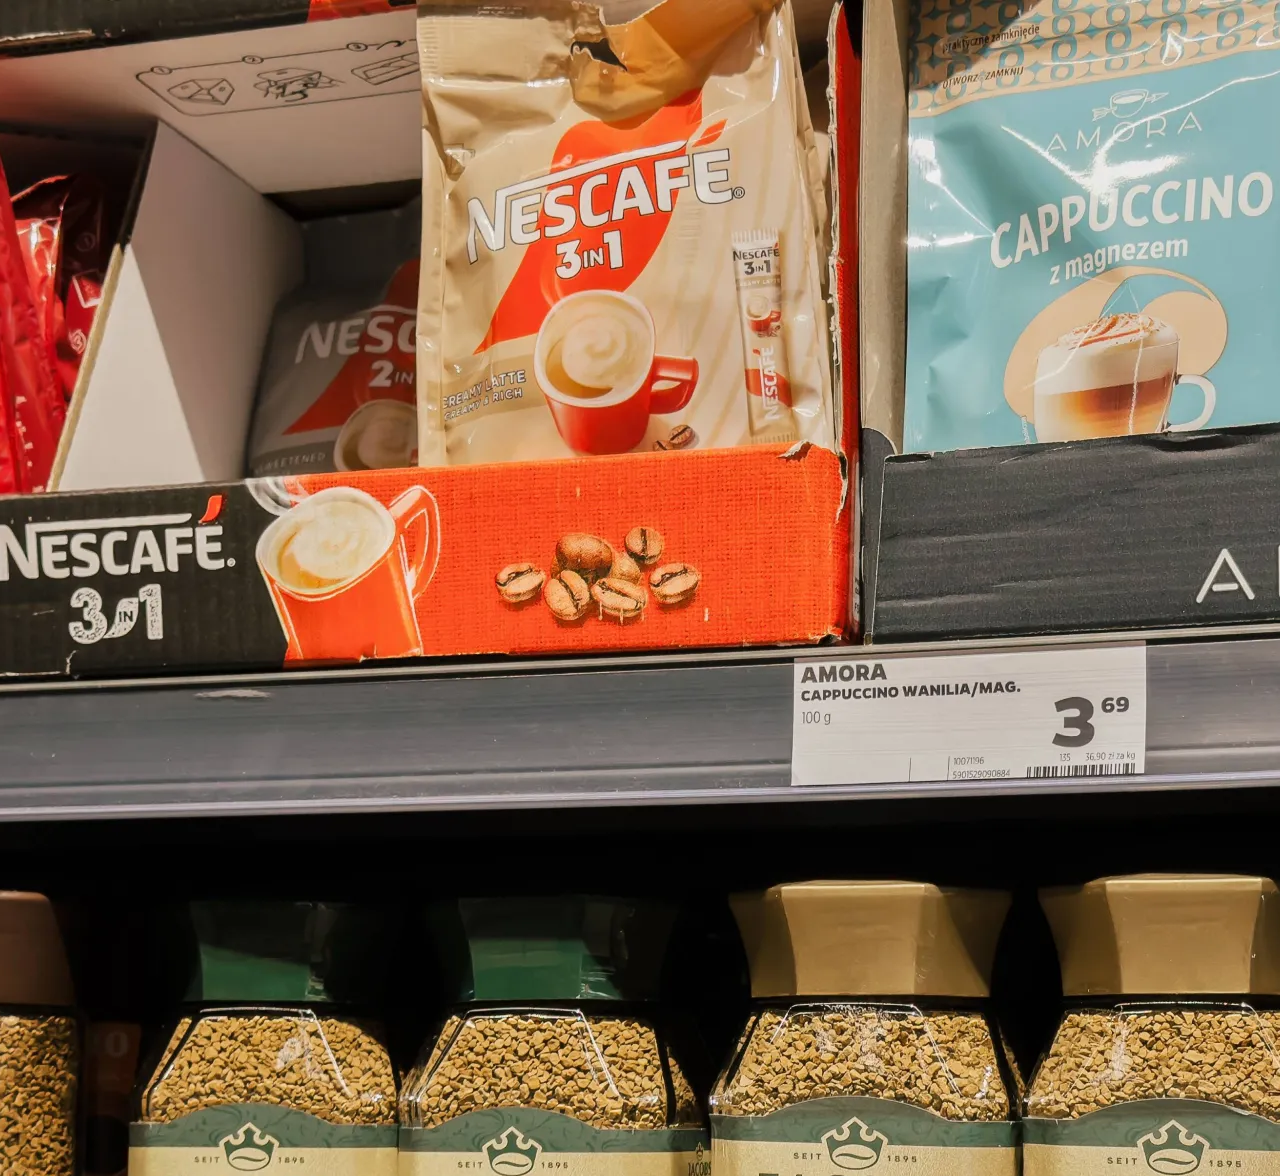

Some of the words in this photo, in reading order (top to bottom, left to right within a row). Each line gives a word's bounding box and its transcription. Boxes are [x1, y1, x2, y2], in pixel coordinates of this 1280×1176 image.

[942, 33, 989, 54] praktyczne
[1045, 111, 1203, 154] AMORA
[989, 170, 1274, 269] CAPPUCCINO
[1050, 263, 1061, 285] z
[1065, 237, 1189, 279] magnezem
[443, 383, 483, 409] CREAMY
[485, 370, 526, 391] LATTE
[492, 388, 522, 401] RICH
[801, 664, 887, 683] AMORA
[801, 686, 899, 702] CAPPUCCINO
[903, 681, 1021, 697] WANILIA/MAG.
[801, 711, 820, 725] 100
[1051, 696, 1095, 748] 3
[1101, 696, 1130, 713] 69
